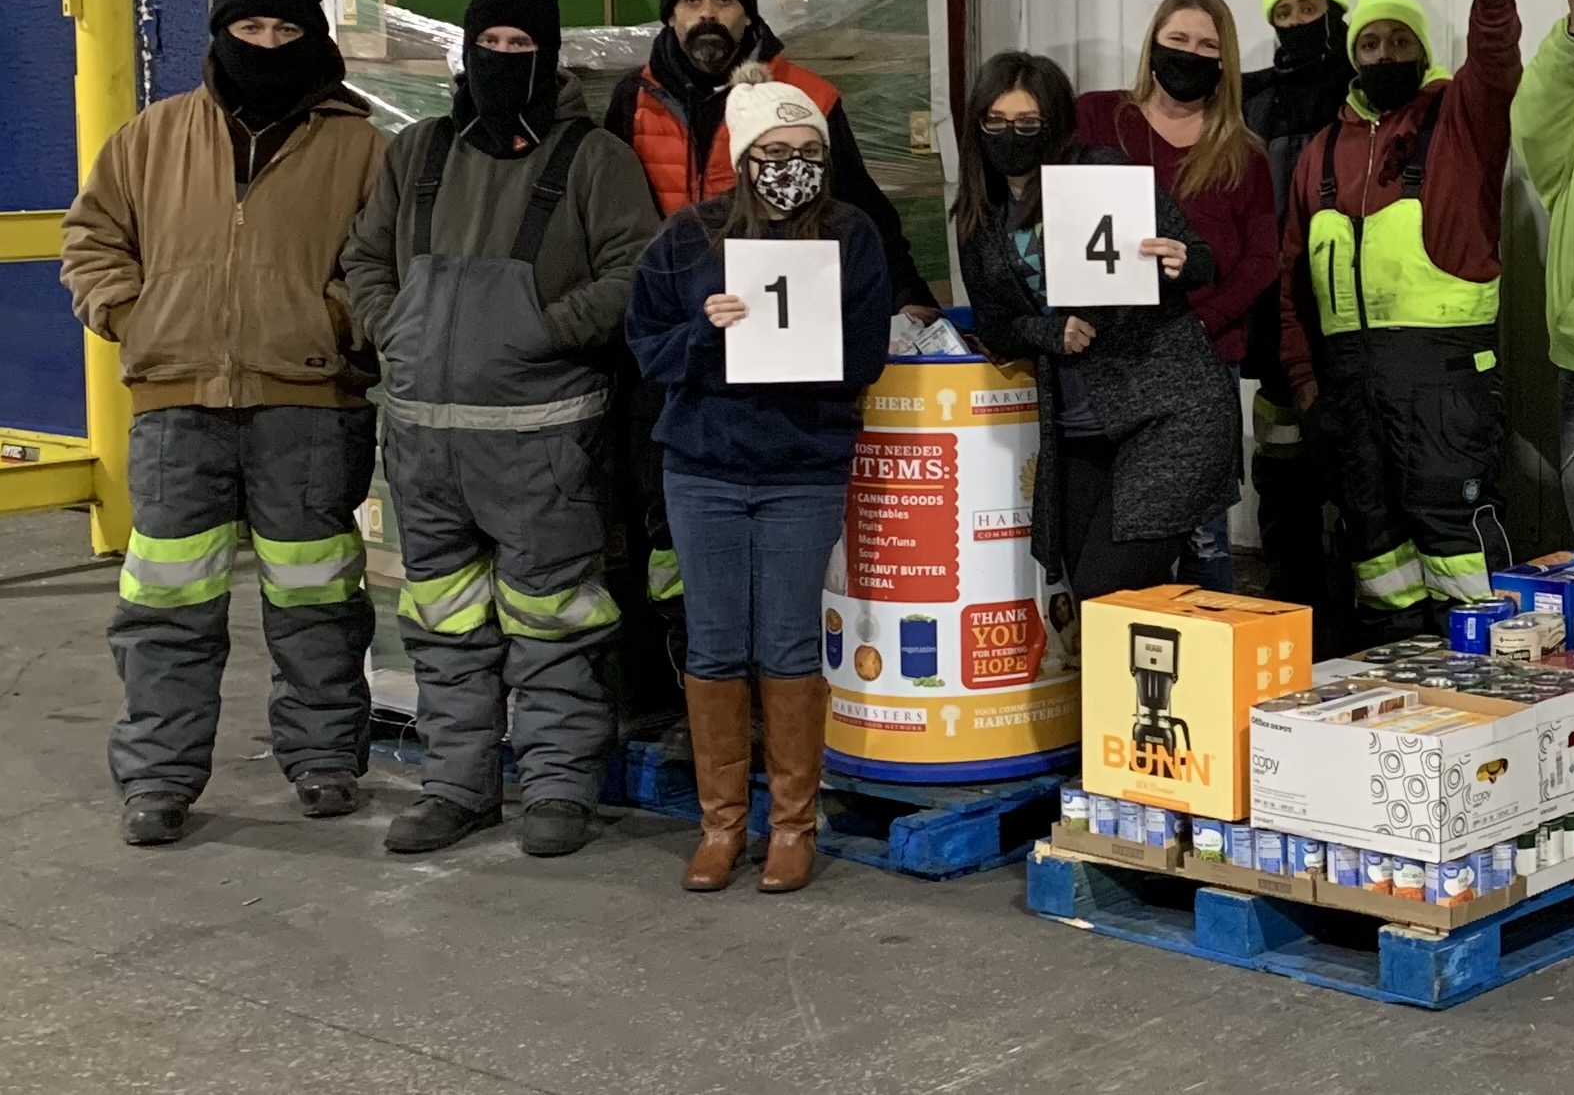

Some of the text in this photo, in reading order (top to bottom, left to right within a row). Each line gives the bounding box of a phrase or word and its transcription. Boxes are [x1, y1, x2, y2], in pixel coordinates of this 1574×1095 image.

[1084, 214, 1121, 274] 4
[764, 275, 789, 330] 1
[874, 396, 925, 412] HERE
[884, 445, 943, 457] NEEDED
[857, 492, 944, 505] CANNED GOODS
[857, 506, 909, 521] Vegetables
[857, 520, 883, 532] Fruits
[858, 534, 916, 548] Meats/Tuna
[858, 547, 880, 560] Soup
[859, 562, 946, 576] PEANUT BUTTER
[859, 576, 895, 589] CEREAL
[970, 607, 1028, 626] THANK
[970, 623, 1028, 648] YOU
[972, 645, 1028, 658] FOR FEEDING
[972, 655, 1028, 675] HOPE
[833, 700, 924, 722] HARVESTERS
[1102, 733, 1211, 787] BUNN
[1252, 754, 1280, 775] copy
[1472, 789, 1492, 803] copy
